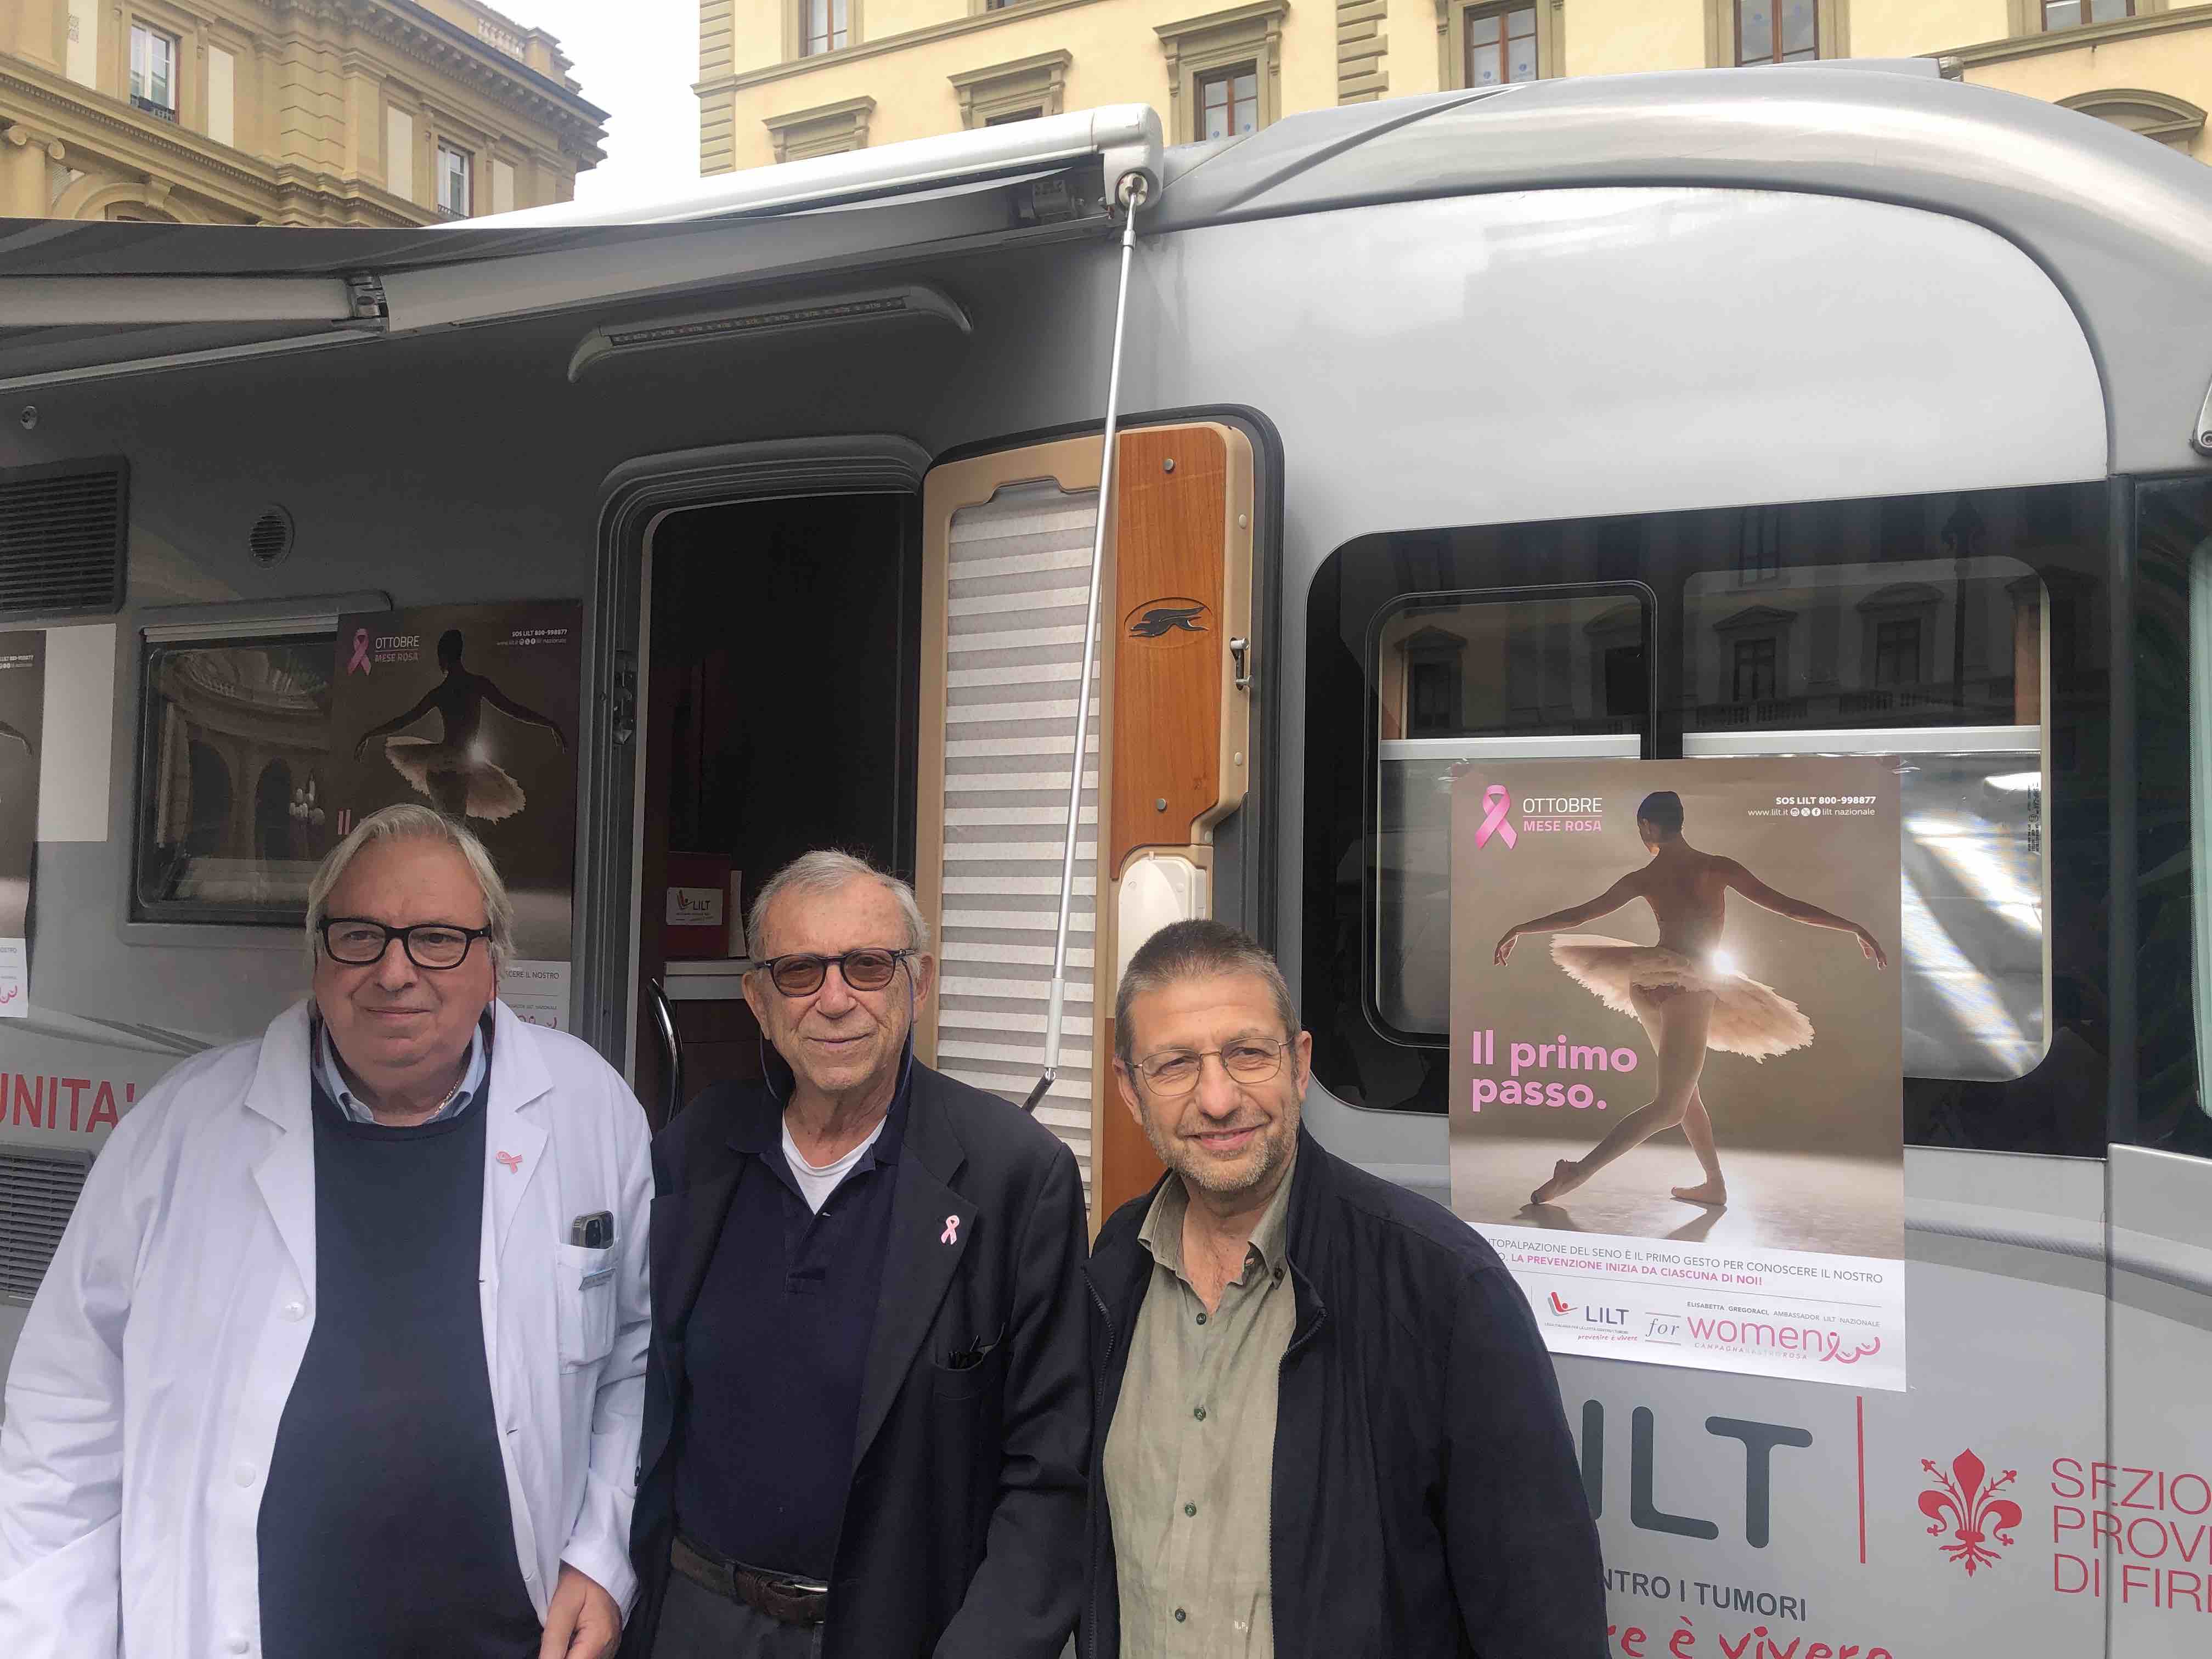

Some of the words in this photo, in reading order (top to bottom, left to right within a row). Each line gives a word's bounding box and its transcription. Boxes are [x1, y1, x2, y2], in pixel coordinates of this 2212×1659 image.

[375, 635, 420, 649] OTTOBRE
[1523, 797, 1602, 813] OTTOBRE
[1747, 808, 1788, 816] www.lilt.it
[1835, 808, 1875, 816] nazionale
[1775, 796, 1795, 805] SOS
[1797, 796, 1817, 804] LILT
[1819, 795, 1876, 804] 800-998877
[1523, 820, 1561, 832] MESE
[1565, 820, 1602, 832] ROSA
[1472, 1029, 1494, 1065] Il
[1510, 1034, 1638, 1076] primo
[1472, 1078, 1607, 1113] passo.
[1488, 1238, 1567, 1254] TOPALPAZIONE
[1570, 1246, 1590, 1256] DEL
[1593, 1248, 1622, 1259] SENO
[1634, 1251, 1643, 1261] IL
[1646, 1252, 1681, 1265] PRIMO
[1683, 1256, 1720, 1268] GESTO
[1724, 1260, 1743, 1270] PER
[1746, 1261, 1818, 1277] CONOSCERE
[1821, 1268, 1831, 1278] IL
[1833, 1269, 1883, 1283] NOSTRO
[1511, 1254, 1524, 1263] LA
[1527, 1255, 1602, 1271] PREVENZIONE
[1606, 1262, 1638, 1273] INIZIA
[1641, 1266, 1658, 1276] DA
[1660, 1267, 1718, 1282] CIASCUNA
[1722, 1273, 1733, 1283] DI
[1736, 1274, 1763, 1285] NOI!
[1586, 1305, 1629, 1325] LILT
[1645, 1318, 1680, 1338] for
[1686, 1301, 1725, 1311] ELISABETTA
[1773, 1311, 1820, 1321] AMBASSADOR
[1839, 1317, 1881, 1328] NAZIONALE
[1687, 1316, 1823, 1353] women
[2054, 1553, 2100, 1598] DI
[2123, 1564, 2212, 1613] FIR
[1679, 1579, 1686, 1602] I
[1694, 1581, 1807, 1622] TUMORI
[1668, 1615, 1696, 1659] è
